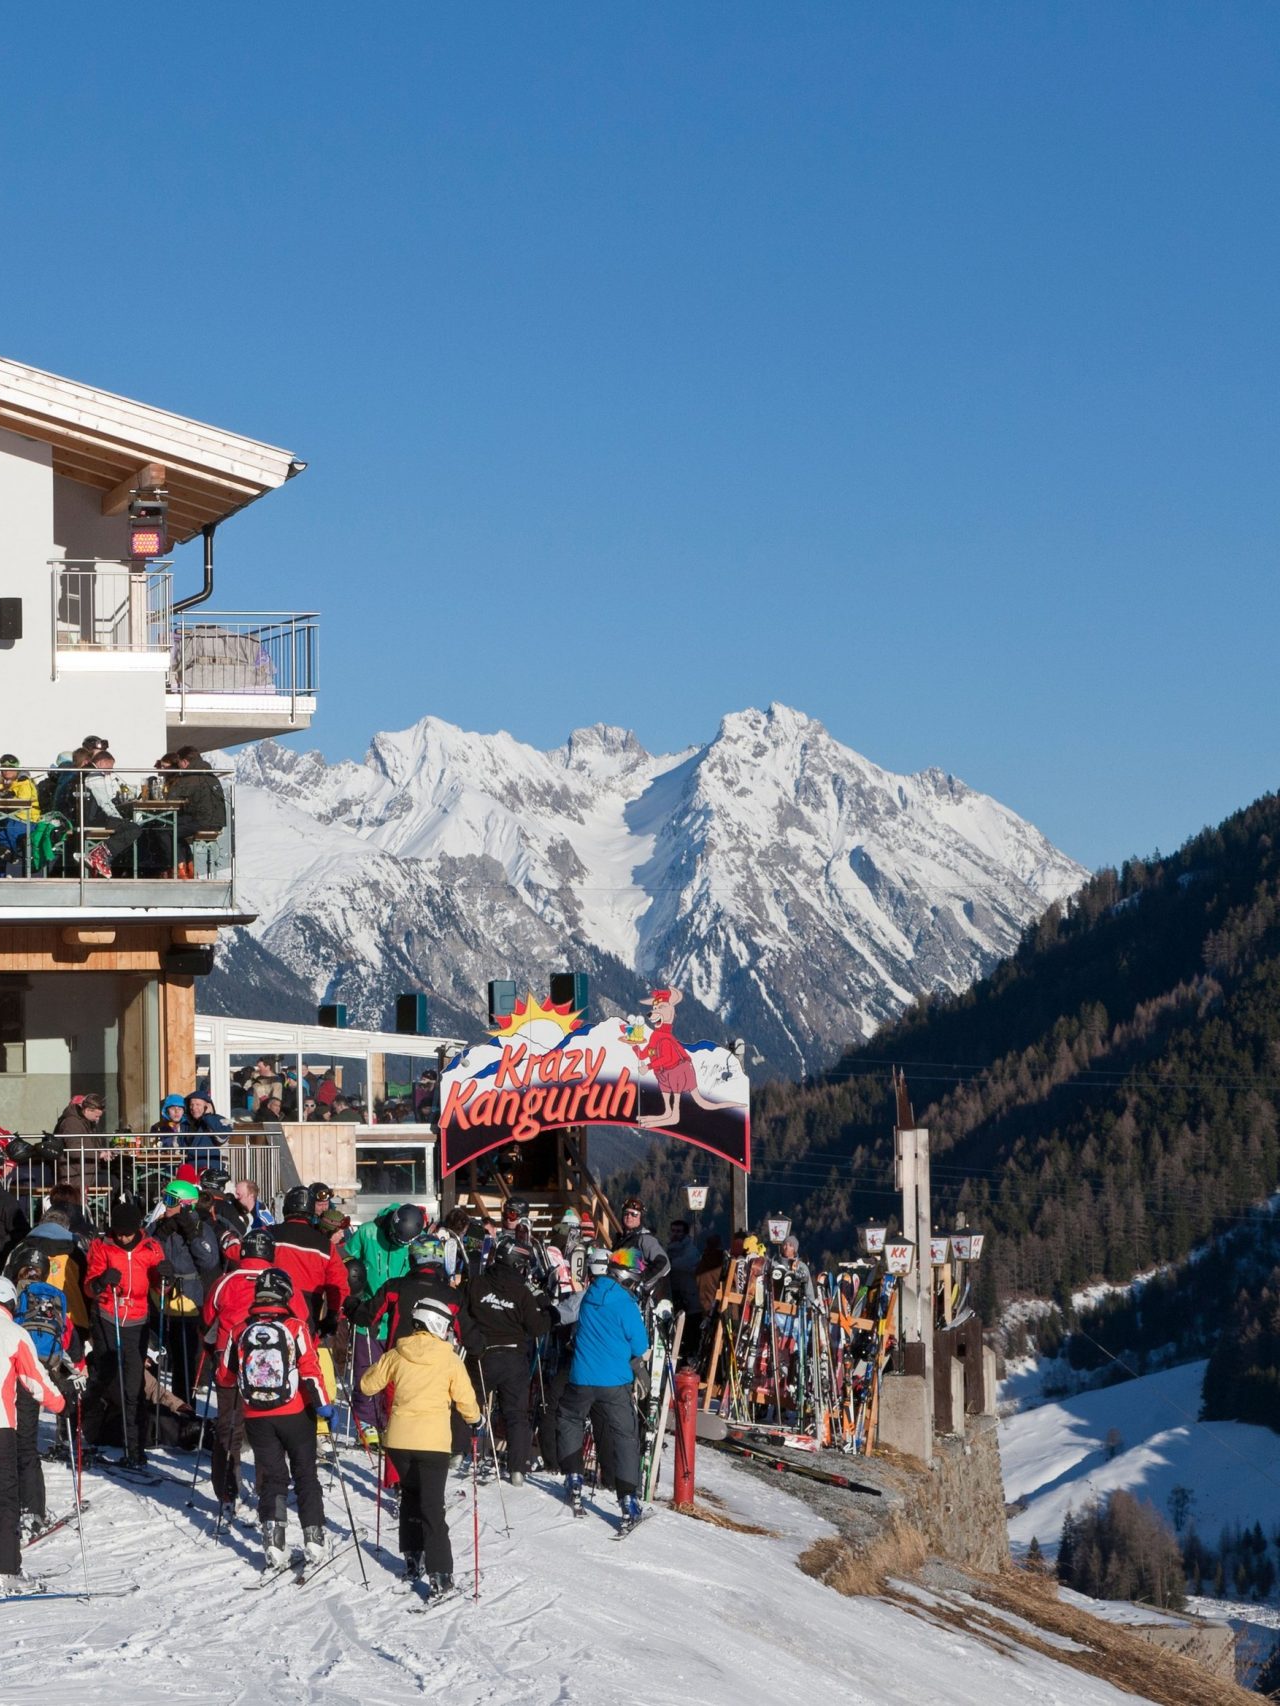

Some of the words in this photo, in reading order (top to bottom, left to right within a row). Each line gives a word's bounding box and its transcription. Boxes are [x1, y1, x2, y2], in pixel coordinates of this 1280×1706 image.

[494, 1042, 607, 1090] Krazy
[438, 1067, 637, 1142] Kanguruh
[691, 1189, 703, 1198] KK
[890, 1246, 908, 1259] KK
